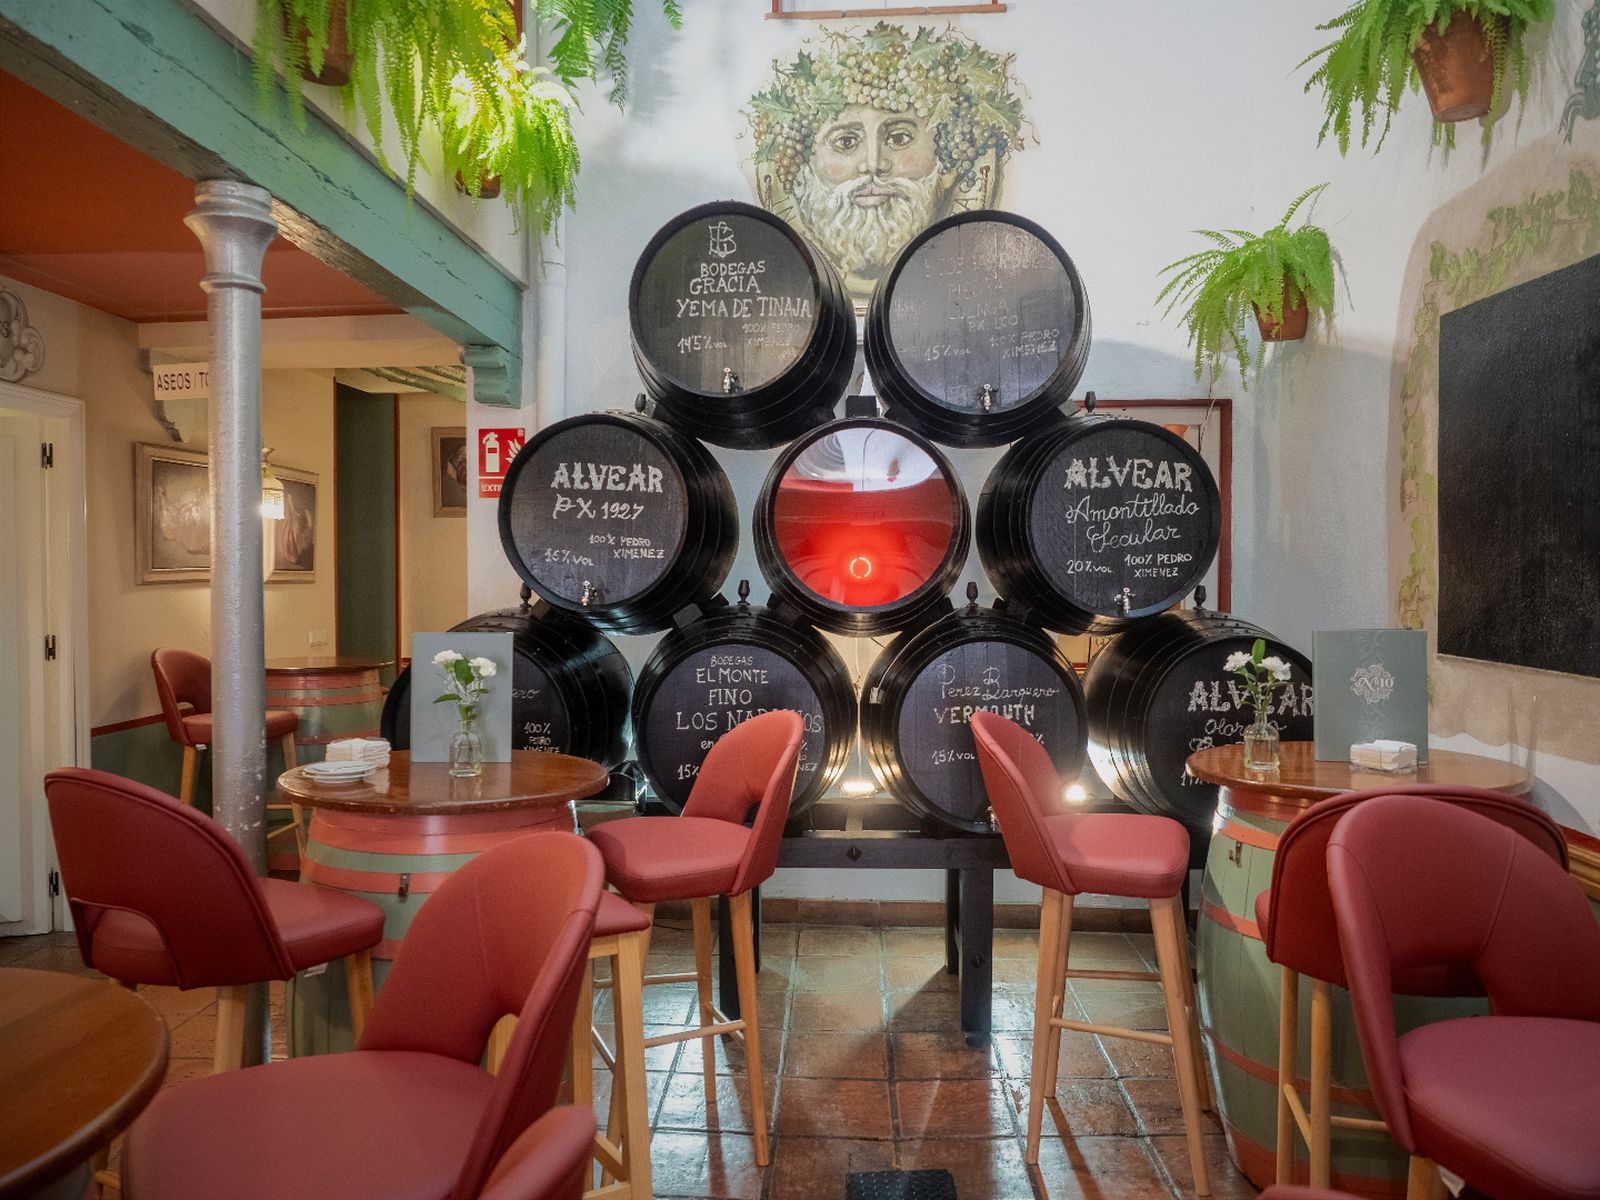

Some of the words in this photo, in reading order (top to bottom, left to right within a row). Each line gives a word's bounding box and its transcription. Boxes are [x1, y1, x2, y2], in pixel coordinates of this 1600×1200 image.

[700, 261, 766, 277] BODEGAS
[690, 276, 761, 294] GRACIA
[676, 298, 729, 318] YEMA
[732, 299, 752, 318] DE
[757, 297, 812, 318] TINAJA
[157, 373, 191, 390] ASEOS
[551, 462, 663, 492] ALVEAR
[1064, 456, 1192, 492] ALVEAR
[601, 501, 644, 520] 1927
[1065, 493, 1200, 524] Amontillado
[589, 532, 616, 545] 100%
[620, 536, 651, 547] PEDRO
[613, 547, 664, 560] XIMENEZ
[1124, 554, 1152, 566] 100%
[1157, 553, 1193, 566] PEDRO
[1066, 560, 1092, 574] 20%
[1134, 567, 1179, 577] XIMENEZ
[710, 656, 754, 667] BODEGAS
[708, 688, 752, 706] FINO
[523, 721, 551, 734] 100%
[676, 711, 718, 730] LOS
[932, 749, 955, 765] 15%
[677, 764, 699, 779] 15%
